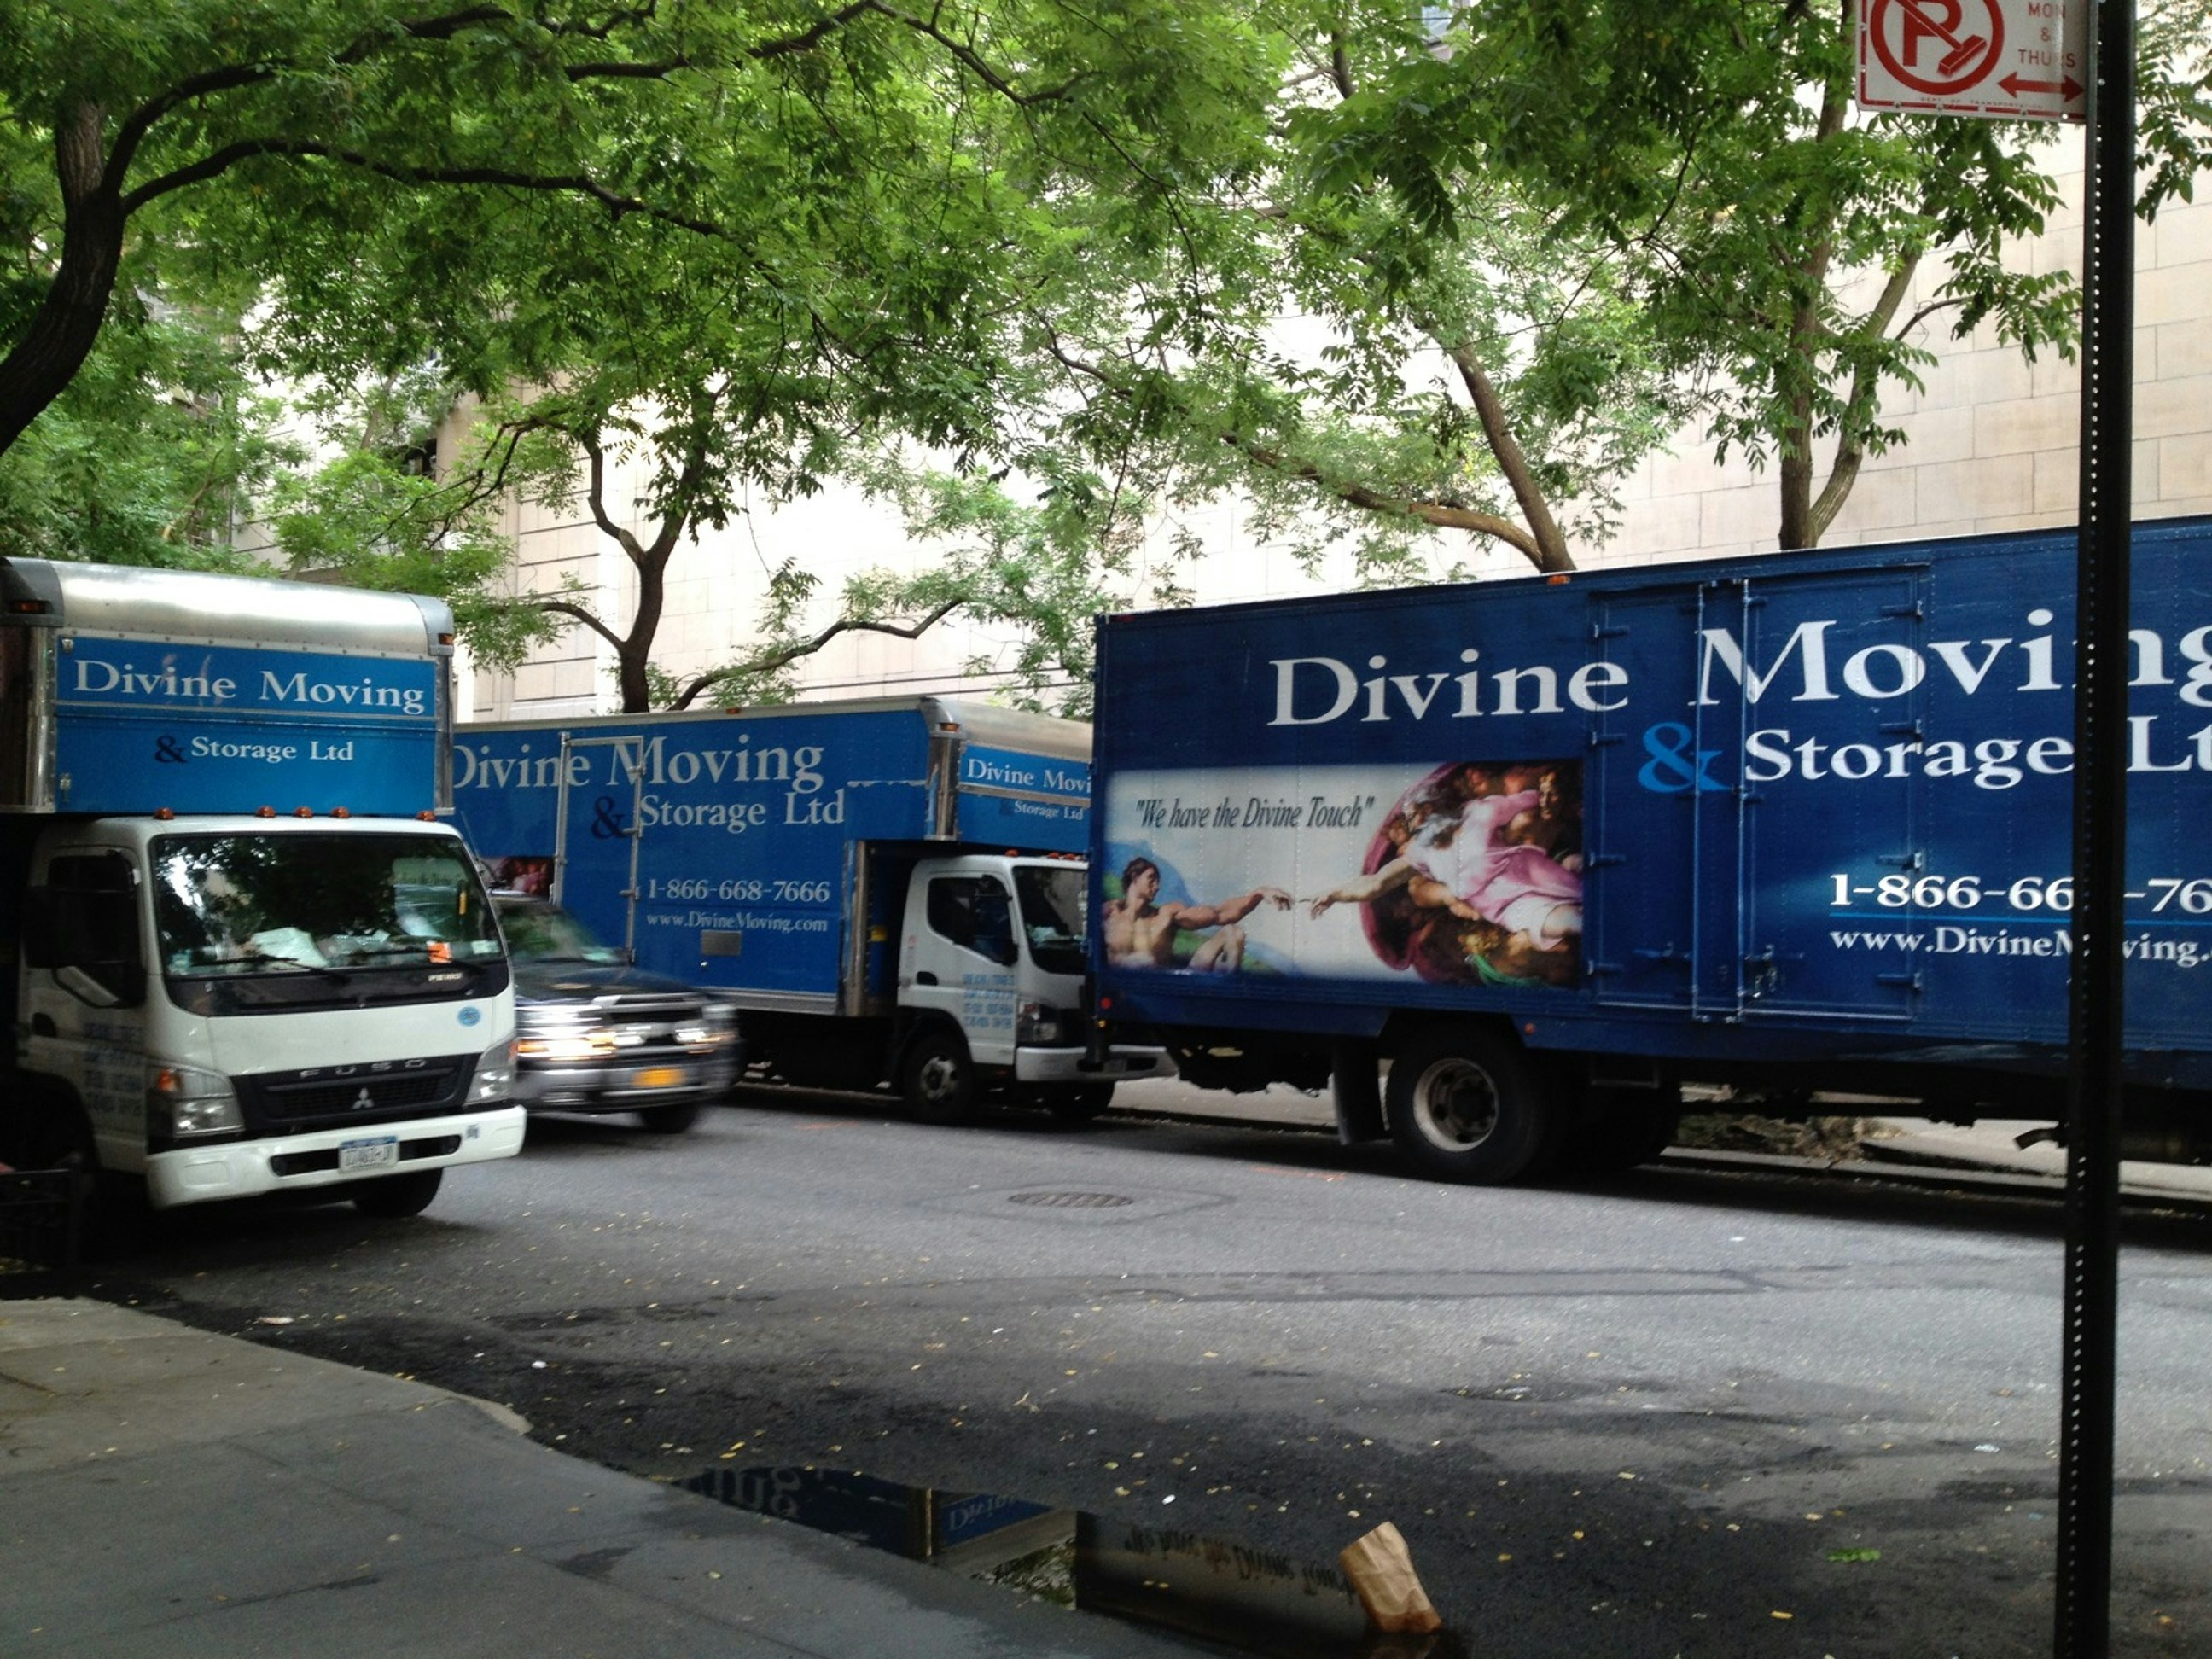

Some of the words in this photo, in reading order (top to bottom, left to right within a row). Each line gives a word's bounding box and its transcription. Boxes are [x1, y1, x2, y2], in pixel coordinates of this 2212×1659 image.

[2028, 2, 2066, 19] MON
[2040, 26, 2052, 42] &
[2017, 48, 2076, 68] THUS
[73, 660, 236, 698] Divine
[259, 671, 425, 715] Moving
[1267, 649, 1629, 725] Divine
[154, 734, 188, 763] &
[191, 736, 297, 764] Storage
[310, 741, 354, 760] Ltd
[606, 734, 824, 794] Moving
[1638, 721, 1736, 794] &
[1744, 729, 2075, 789] Storage
[2127, 715, 2212, 771] Lt
[967, 758, 1034, 785] Divine
[1043, 770, 1091, 794] Movi
[591, 795, 629, 840] &
[640, 795, 766, 834] Storage
[783, 788, 845, 824] Ltd
[1014, 800, 1059, 818] Storage
[1064, 806, 1084, 821] Ltd
[1136, 798, 1166, 828] "We
[1168, 798, 1208, 828] have
[1212, 797, 1238, 828] the
[1243, 797, 1302, 828] Divine
[1306, 795, 1375, 828] Touch"
[649, 878, 830, 903] 1-866-668-7666
[1830, 874, 2212, 914] 1-866-66-76
[647, 911, 828, 934] www.DivineMoving.com
[1830, 926, 2212, 968] www.DivineMving.
[300, 1059, 426, 1079] FUSO
